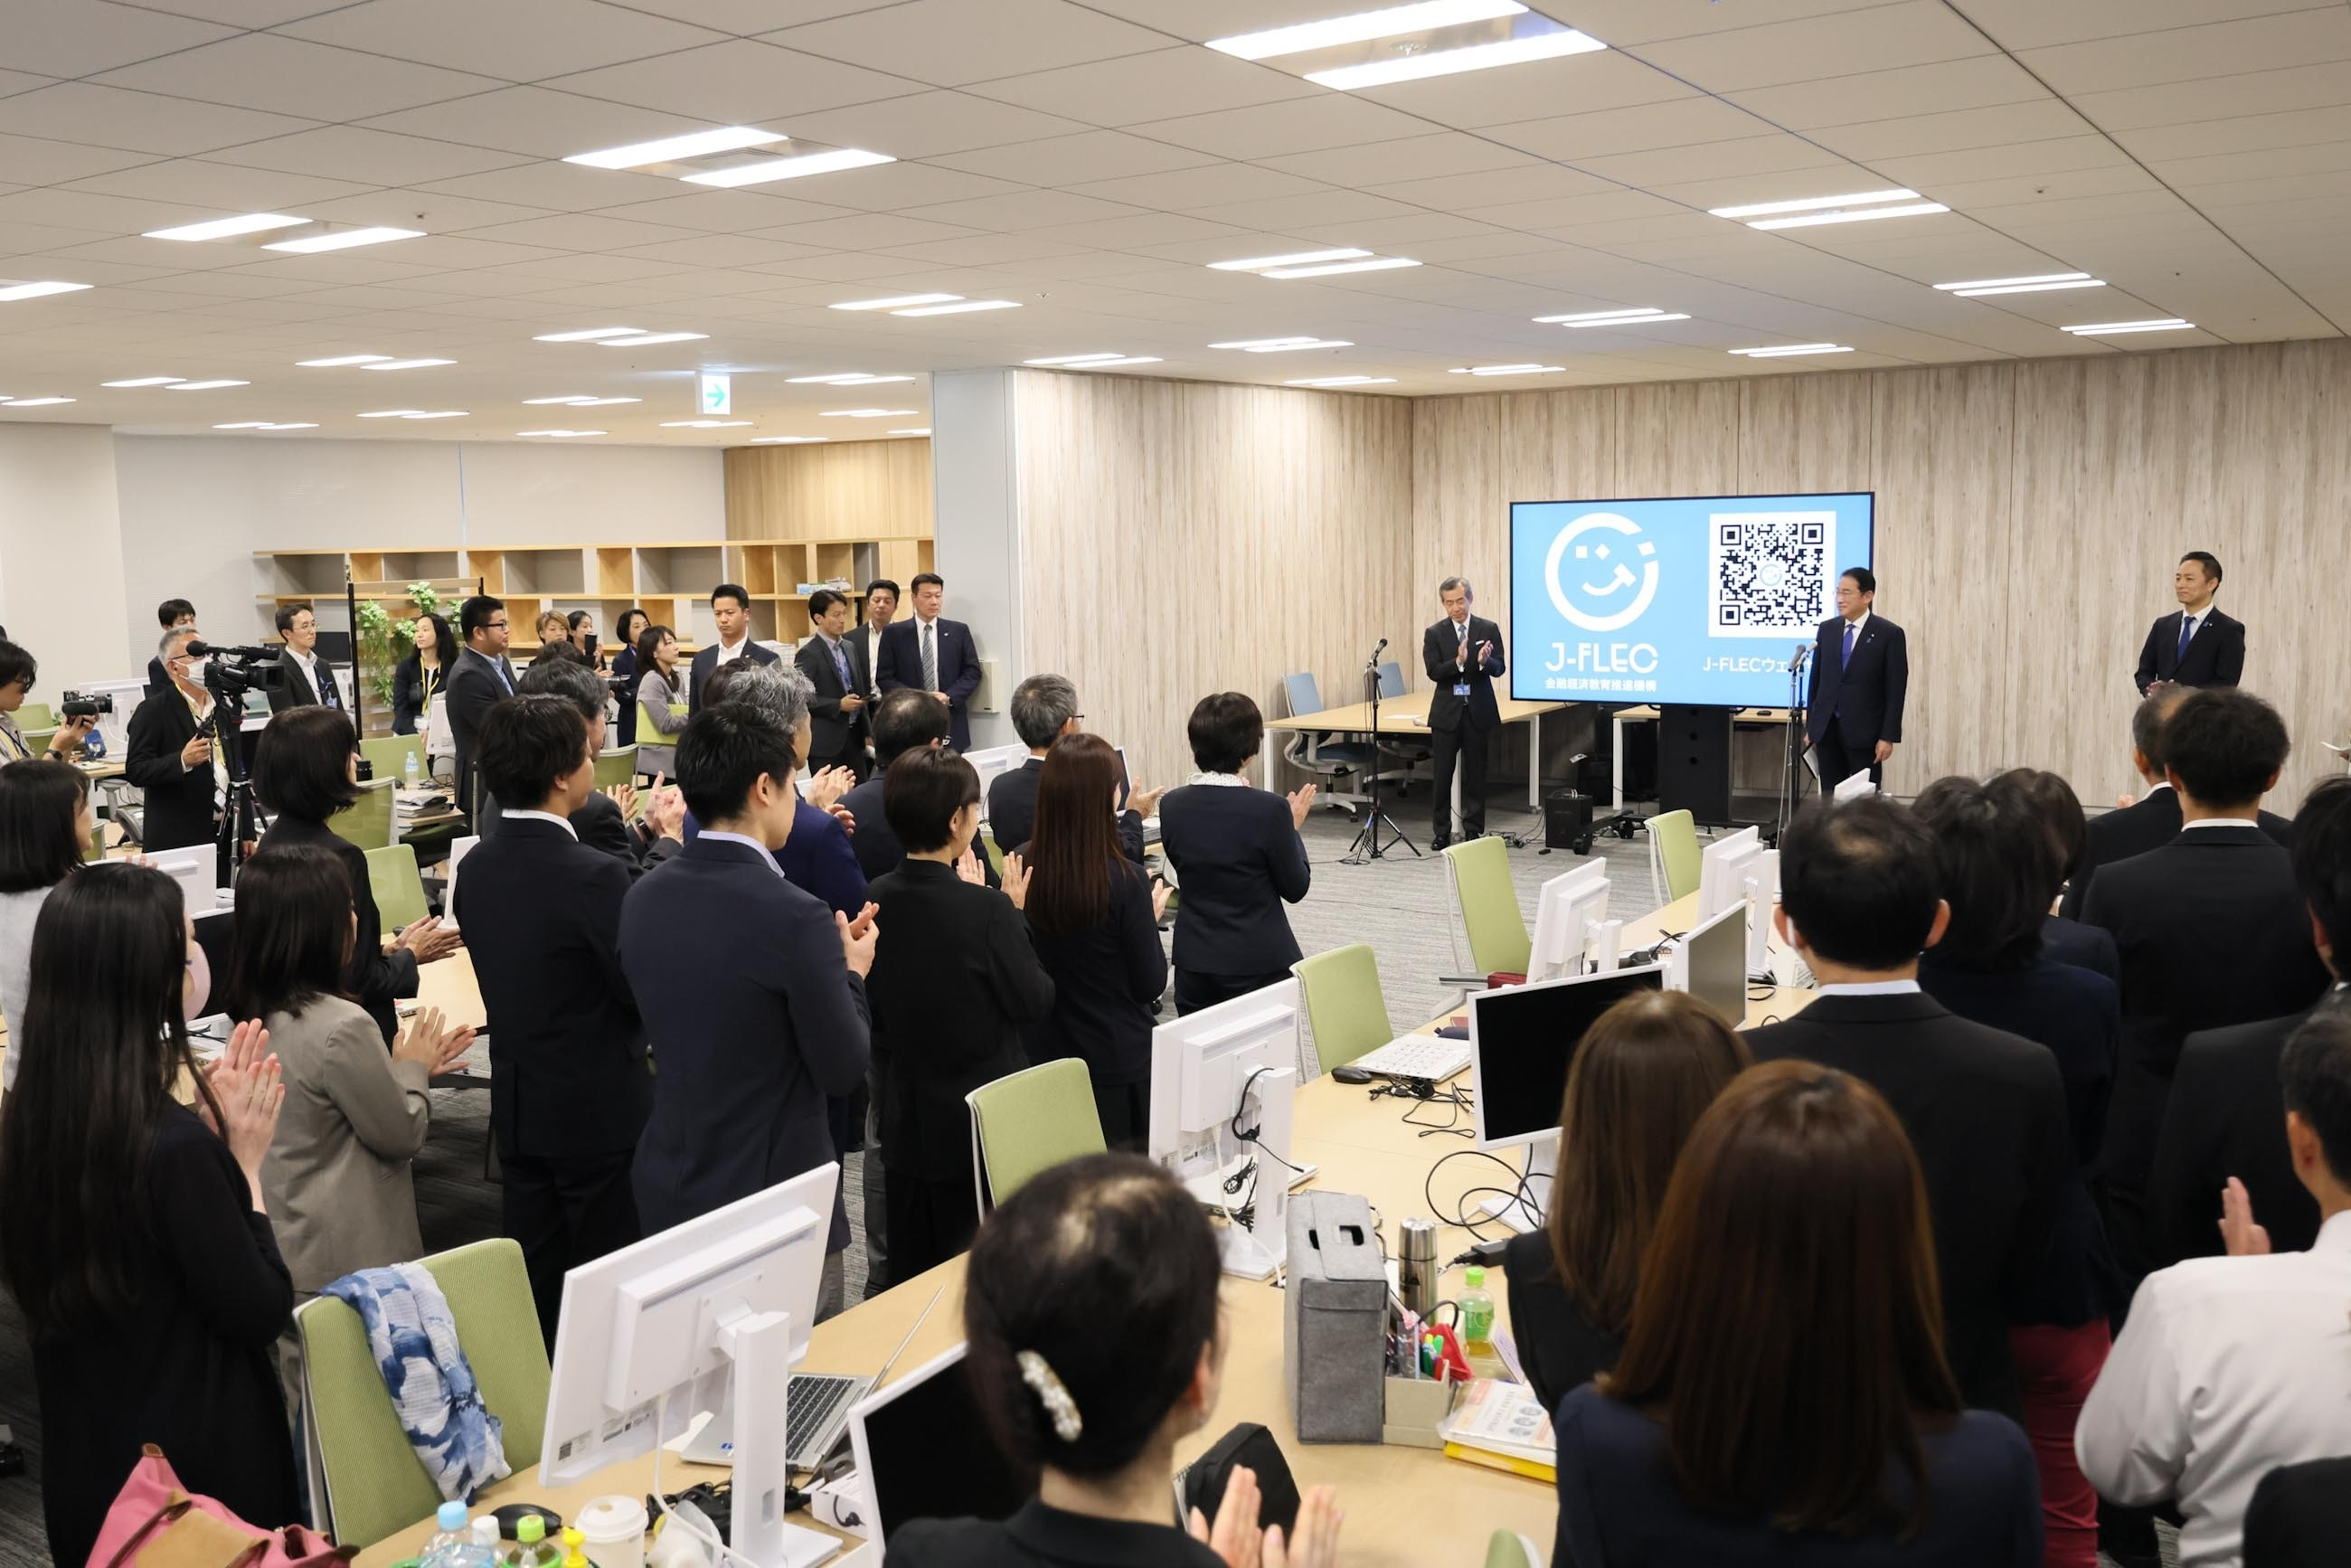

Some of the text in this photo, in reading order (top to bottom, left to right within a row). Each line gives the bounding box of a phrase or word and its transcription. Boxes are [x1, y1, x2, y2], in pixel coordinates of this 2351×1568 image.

[1544, 642, 1658, 673] J-FLEC
[1703, 657, 1812, 673] J-FLECウェ
[1544, 677, 1657, 693] 金融経済教育推進機構
